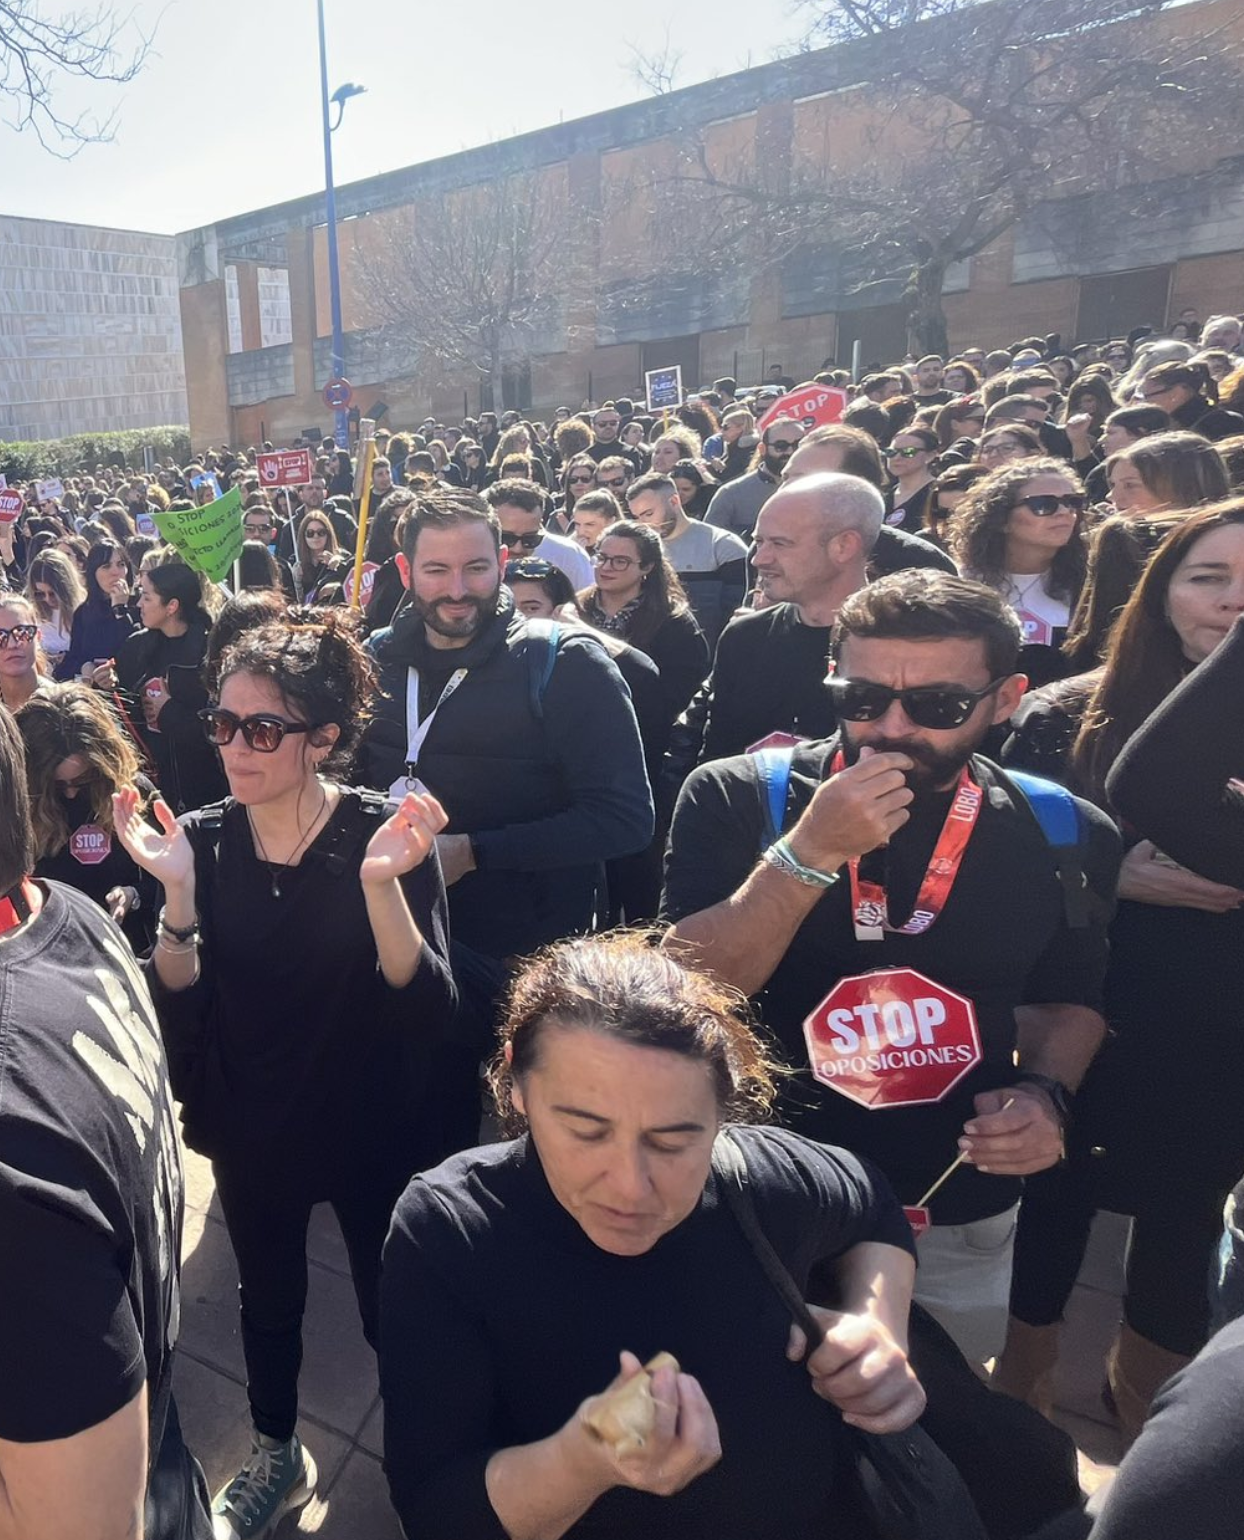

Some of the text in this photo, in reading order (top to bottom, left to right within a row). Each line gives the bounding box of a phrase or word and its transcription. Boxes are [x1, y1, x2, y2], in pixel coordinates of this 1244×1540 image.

[177, 509, 205, 524] STOP
[950, 786, 980, 823] LOBO
[76, 833, 105, 848] STOP
[826, 997, 947, 1055] STOP
[821, 1044, 973, 1077] OPOSICIONES
